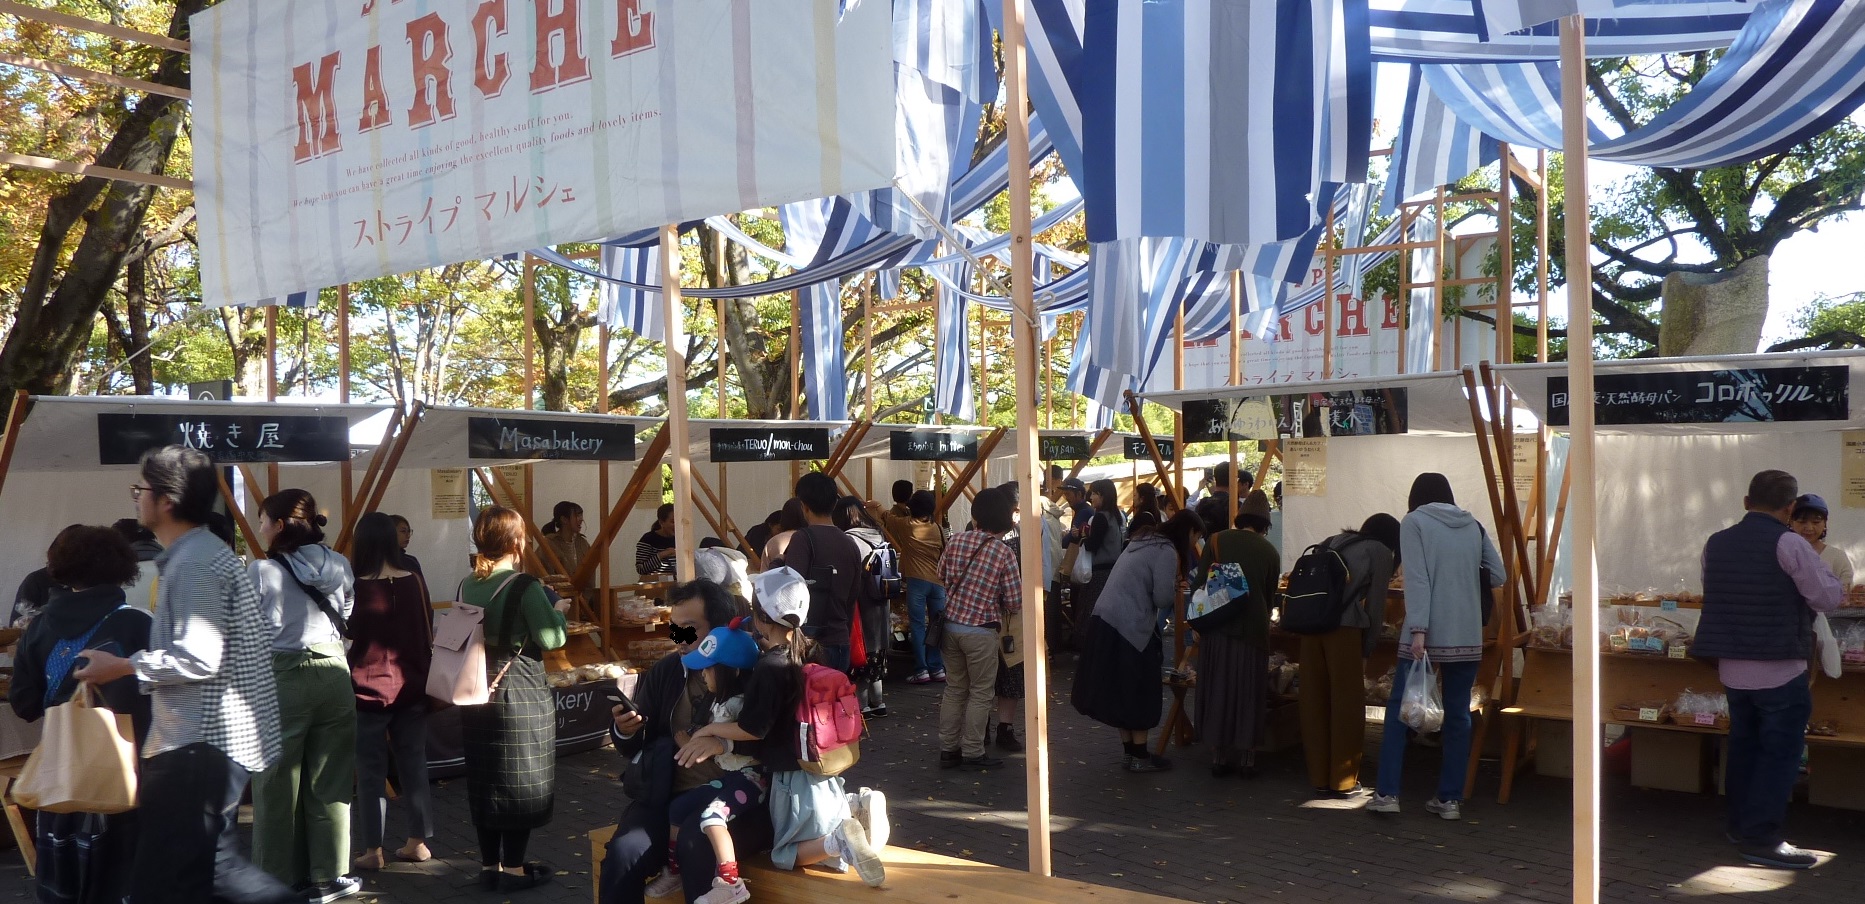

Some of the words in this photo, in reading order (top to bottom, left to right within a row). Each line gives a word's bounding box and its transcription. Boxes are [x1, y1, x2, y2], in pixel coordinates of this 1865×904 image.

[293, 0, 656, 165] MARCHE
[293, 199, 303, 208] We
[304, 195, 319, 208] hope
[320, 191, 335, 202] that
[335, 188, 347, 199] you
[348, 184, 361, 194] can
[361, 180, 377, 191] have
[386, 173, 405, 187] great
[406, 168, 423, 180] time
[424, 158, 458, 176] enjoying
[459, 153, 473, 165] the
[475, 143, 513, 162] excellent
[516, 135, 547, 154] quality
[550, 127, 575, 143] foods
[577, 121, 596, 135] and
[598, 114, 627, 131] lovely
[630, 108, 663, 124] items.
[346, 168, 356, 178] We
[358, 165, 373, 176] have
[375, 155, 407, 171] collected
[409, 150, 419, 161] all
[421, 144, 443, 158] kinds
[445, 140, 454, 151] of
[479, 124, 511, 142] healthy
[513, 117, 535, 133] stuff
[537, 116, 551, 127] for
[553, 111, 574, 126] you.
[353, 194, 463, 250] ストライプ
[474, 174, 577, 222] マルシェ
[1551, 387, 1683, 409] 国・天然酵母パン
[1694, 380, 1816, 405] コロボックル
[179, 421, 285, 450] 焼き屋
[499, 426, 603, 454] Masabakery
[1043, 440, 1075, 456] Paysan
